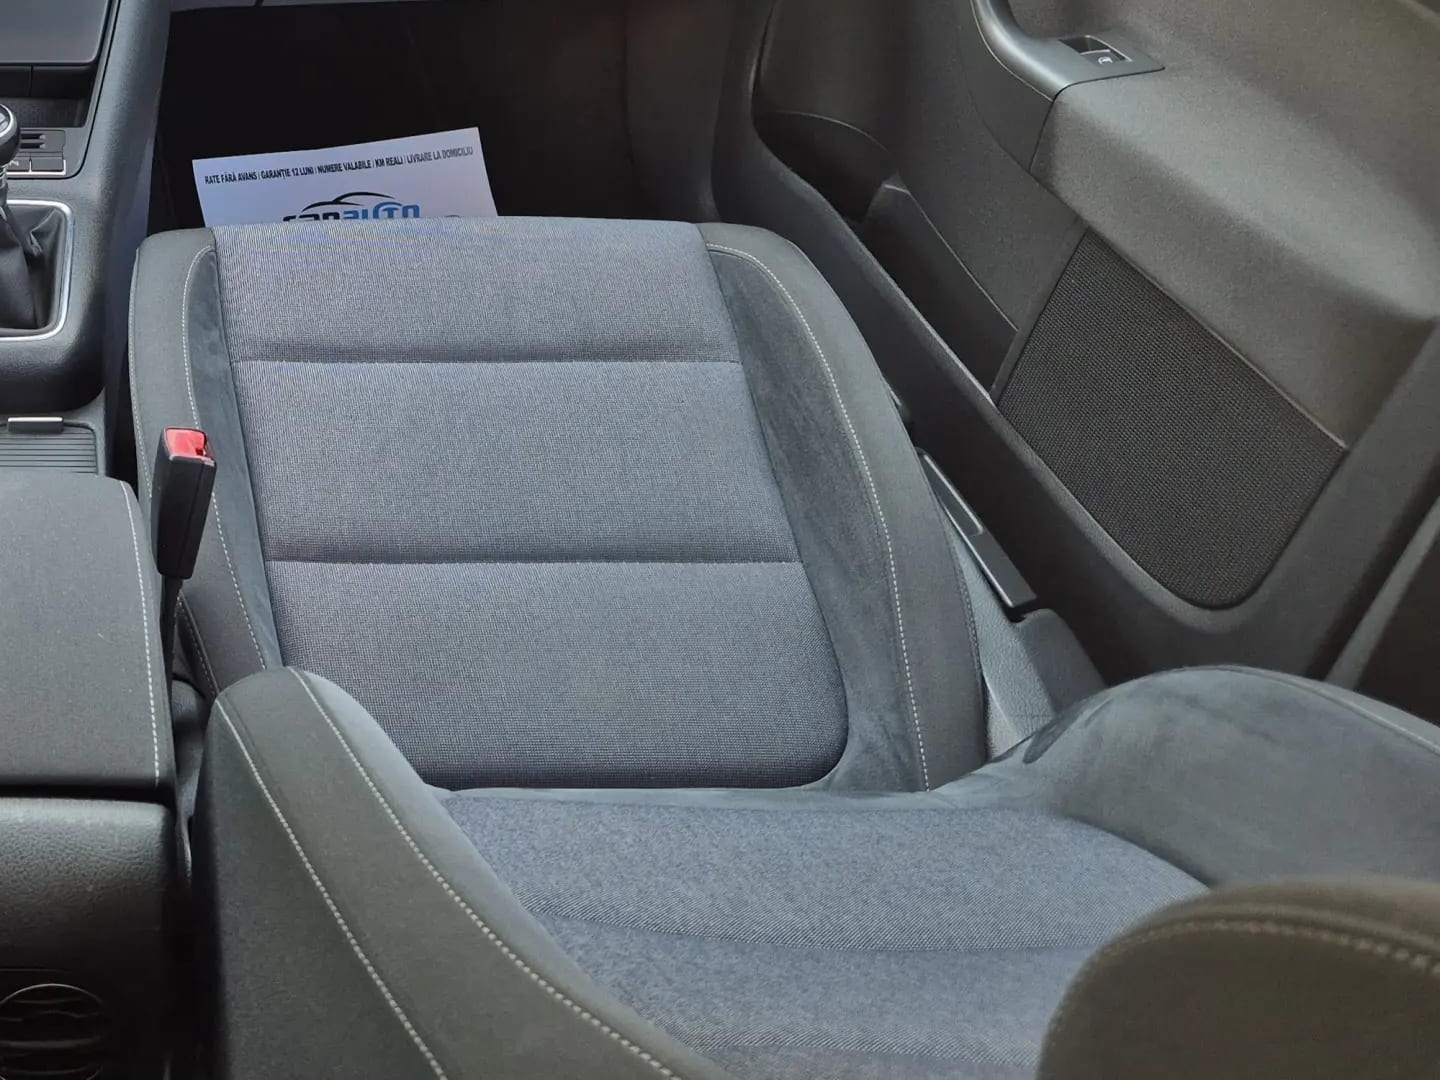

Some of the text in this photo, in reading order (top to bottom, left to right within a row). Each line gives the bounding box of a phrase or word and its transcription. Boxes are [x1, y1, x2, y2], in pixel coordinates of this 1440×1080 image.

[204, 175, 221, 185] RATE
[238, 171, 258, 182] AVANS
[291, 167, 299, 177] 12
[300, 166, 314, 176] LUNI
[317, 162, 343, 173] NUMERE
[343, 160, 372, 171] VALABILE
[375, 159, 385, 167] KM
[386, 156, 403, 166] REALI
[407, 151, 433, 163] LIVRARE
[433, 150, 442, 160] LA
[442, 146, 474, 158] DOMICILIU
